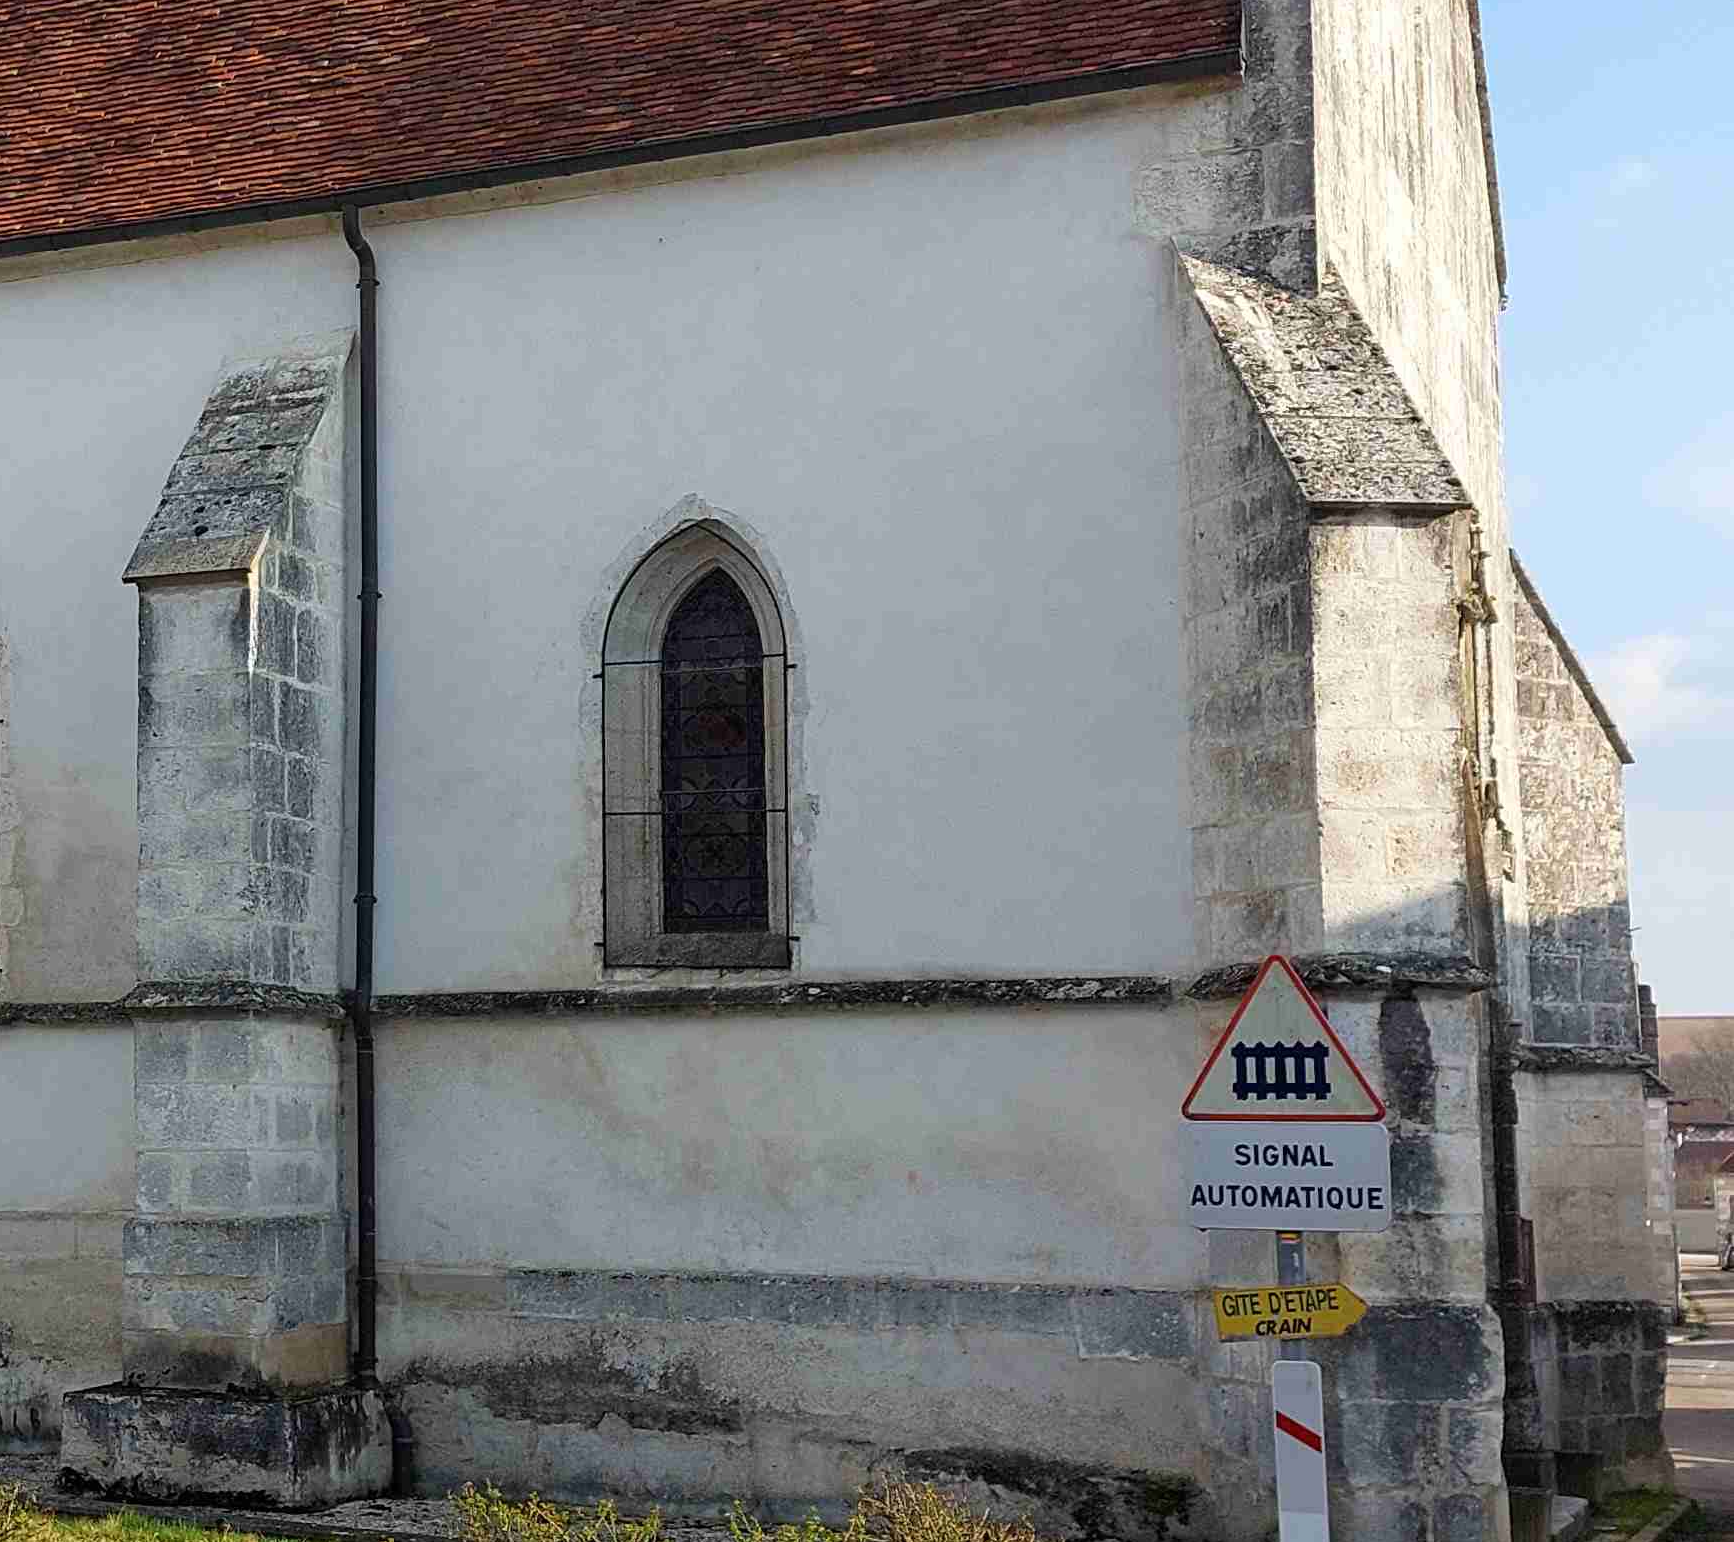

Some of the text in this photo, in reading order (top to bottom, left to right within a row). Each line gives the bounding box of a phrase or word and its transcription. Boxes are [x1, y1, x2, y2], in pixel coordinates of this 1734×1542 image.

[1234, 1144, 1334, 1167] SIGNAL
[1191, 1184, 1384, 1210] AUTOMATIQUE
[1222, 1288, 1339, 1317] GITE D'ETAPE
[1255, 1317, 1312, 1336] CRAIN
